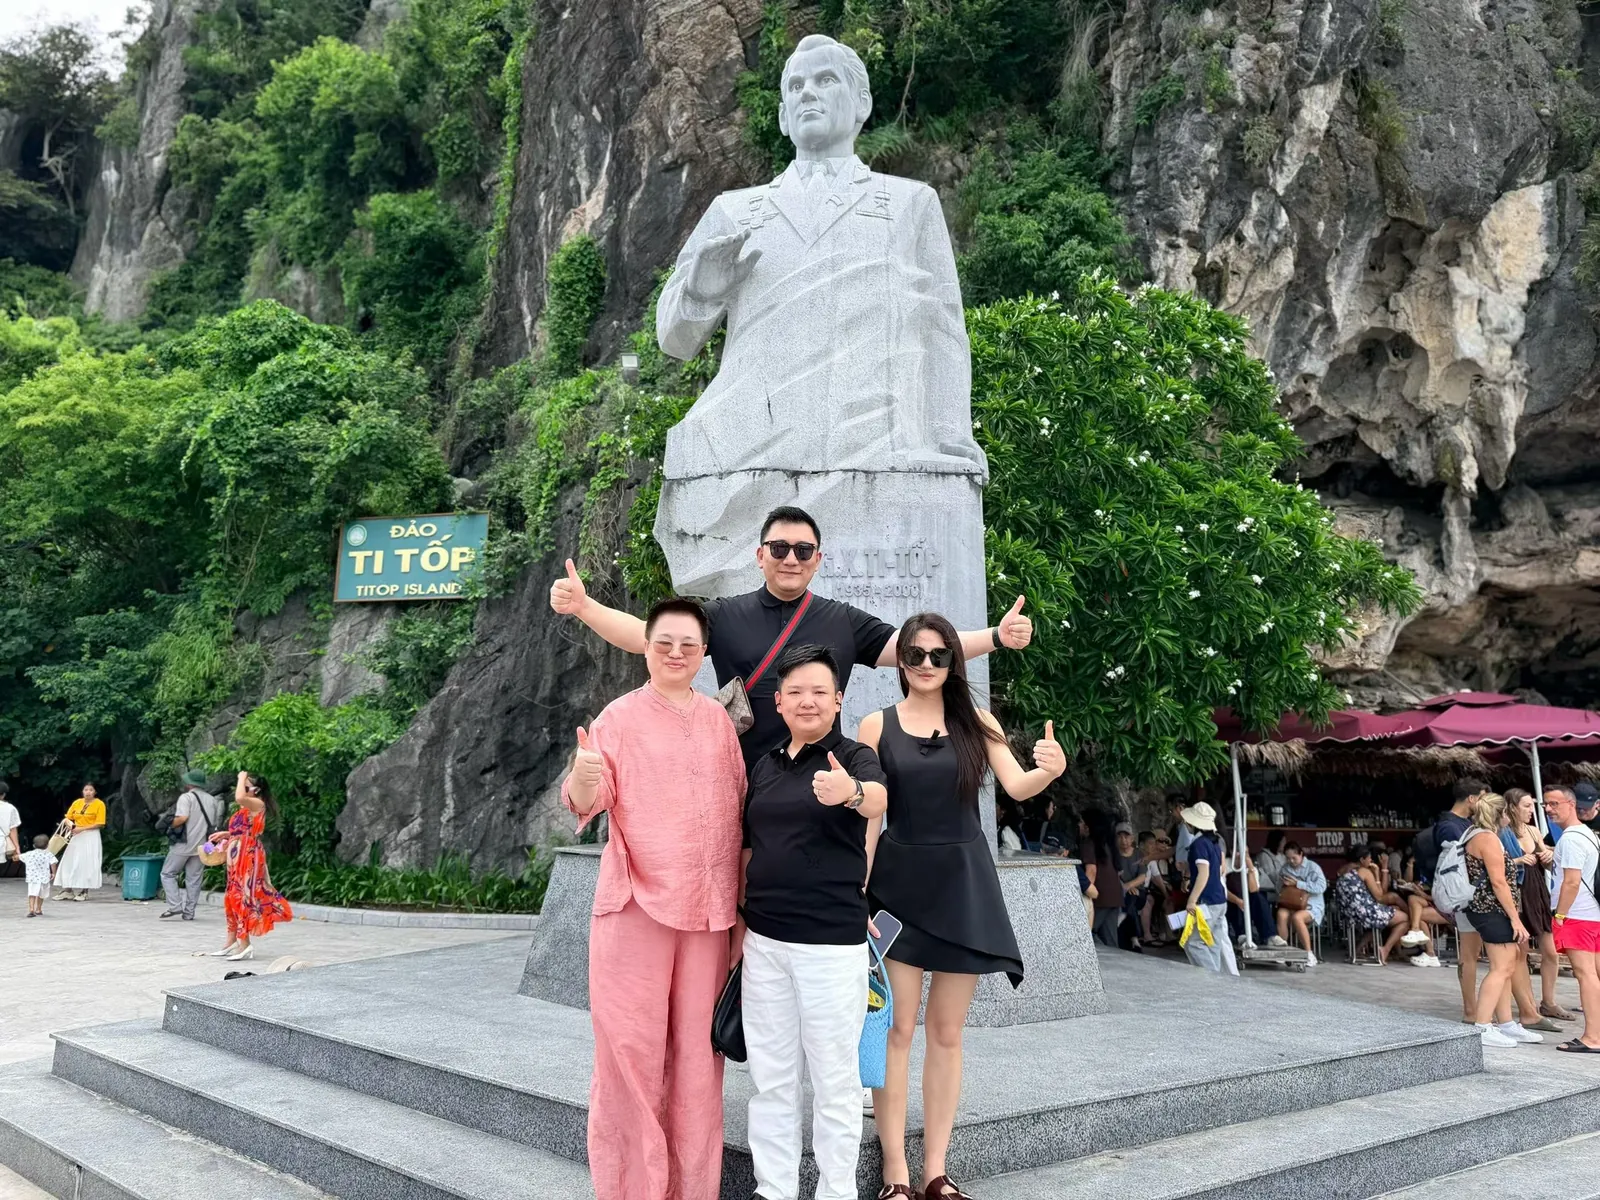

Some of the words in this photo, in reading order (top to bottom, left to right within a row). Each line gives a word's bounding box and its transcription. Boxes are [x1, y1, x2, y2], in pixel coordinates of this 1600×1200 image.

[389, 519, 437, 538] ĐẢO
[348, 550, 384, 575] TI
[394, 534, 475, 573] TỐP
[356, 584, 399, 596] TITOP
[404, 582, 462, 595] ISLAND
[1315, 831, 1344, 846] TITOP
[1350, 831, 1368, 845] BAR
